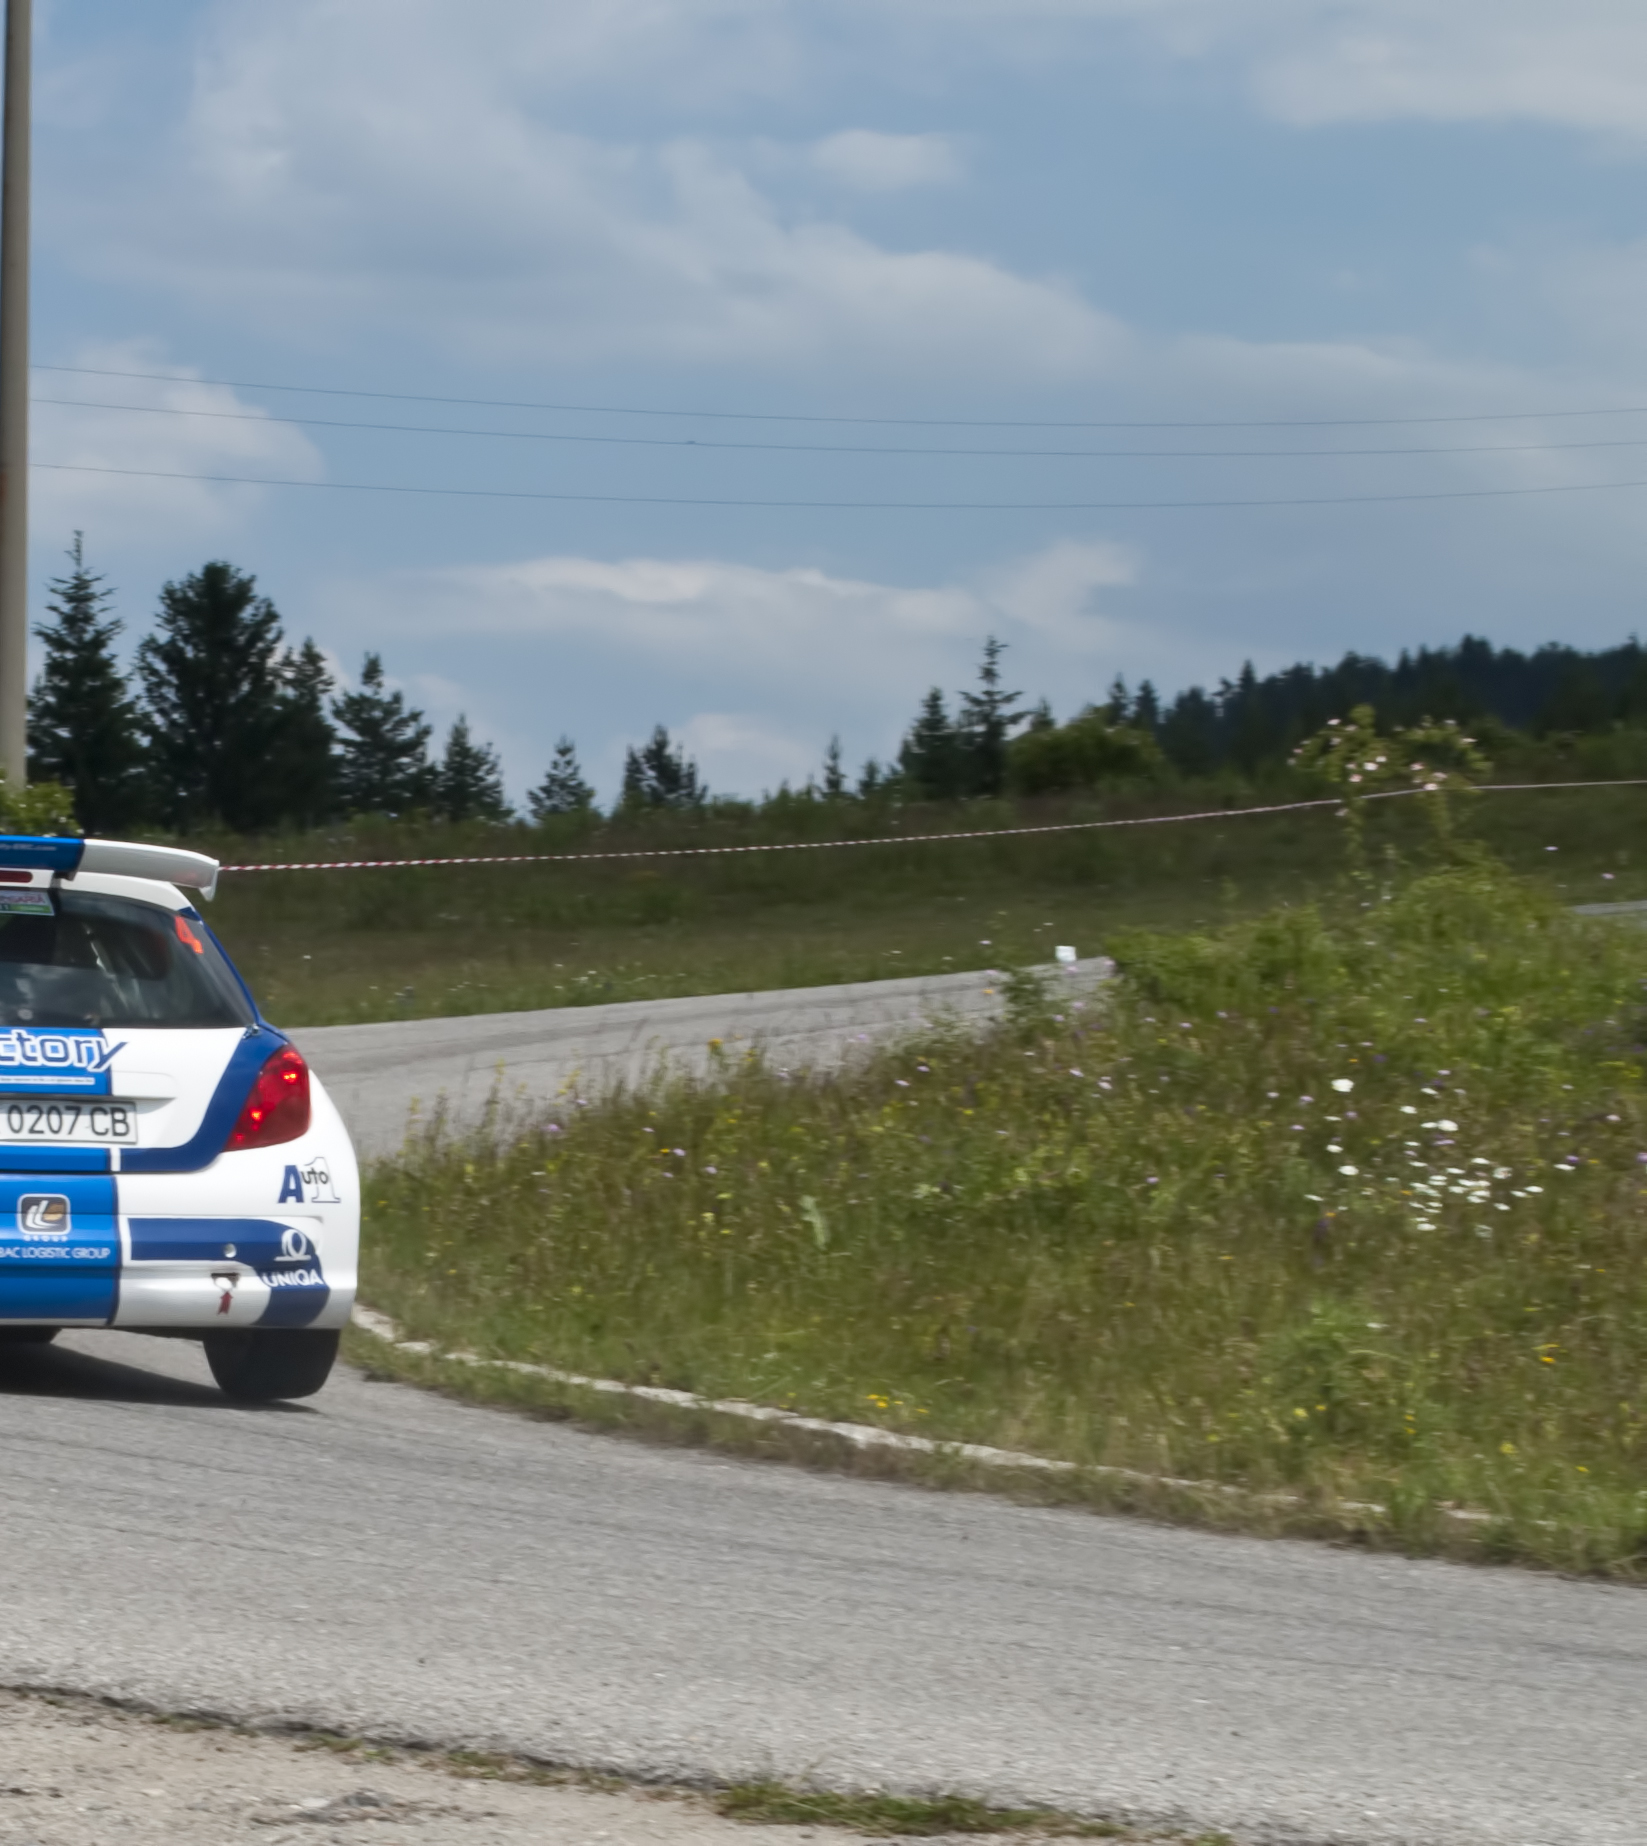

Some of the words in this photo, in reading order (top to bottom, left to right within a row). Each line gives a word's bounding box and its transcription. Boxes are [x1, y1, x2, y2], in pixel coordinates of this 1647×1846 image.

[174, 914, 204, 954] 4
[7, 1104, 82, 1136] 0207
[89, 1106, 130, 1137] CB
[21, 1246, 71, 1259] LOGISTIC
[72, 1247, 111, 1259] GROUP
[262, 1269, 324, 1287] UNIQA
